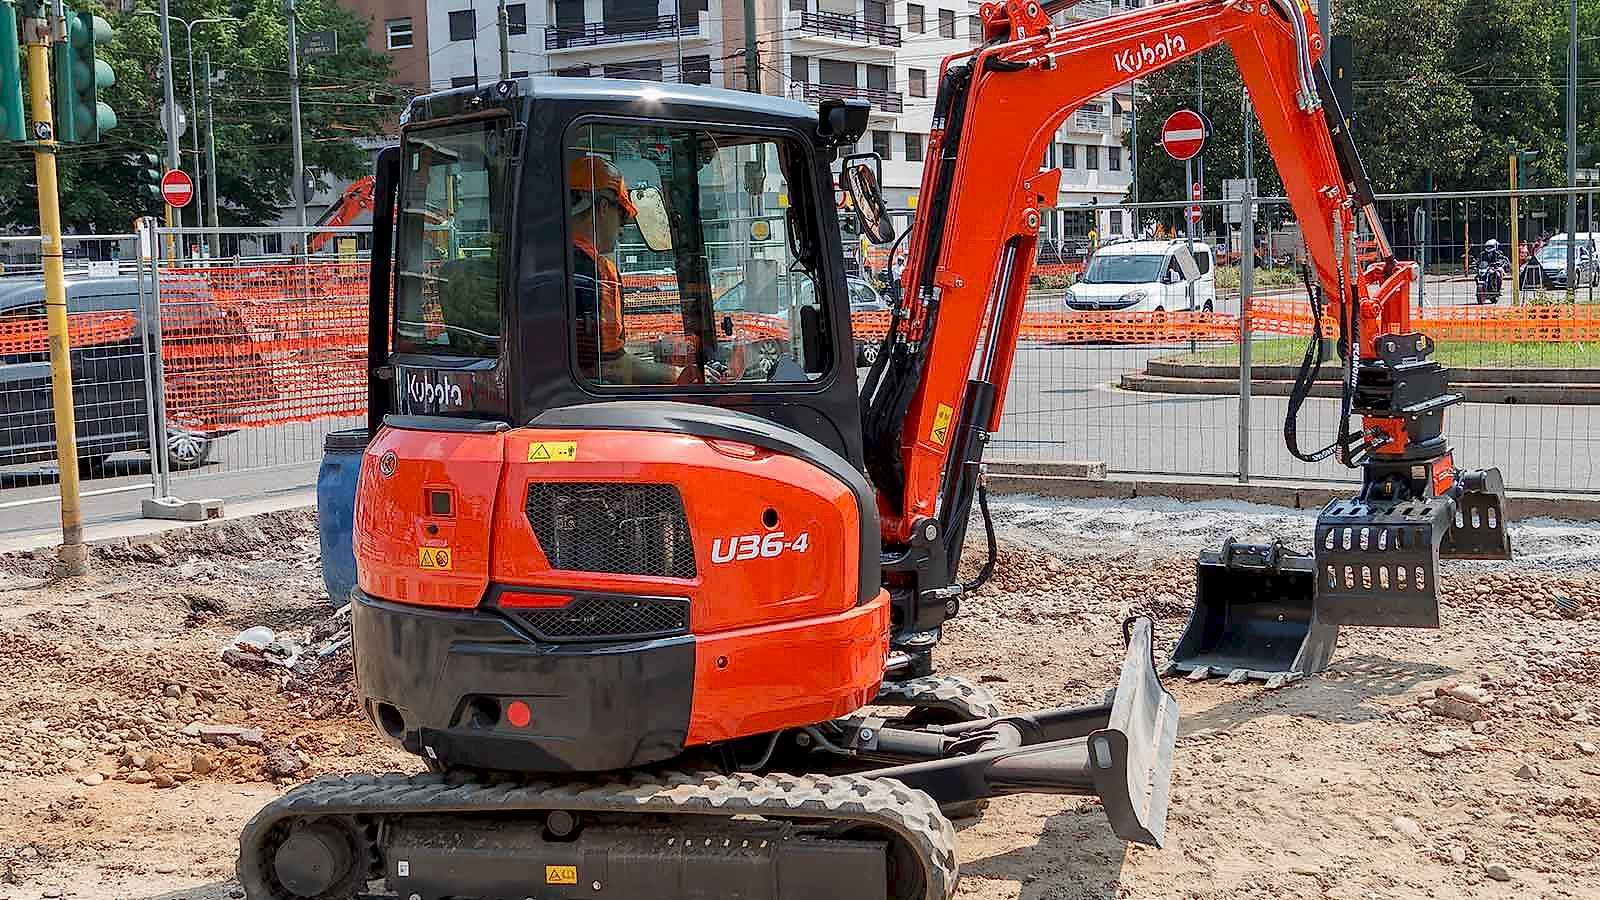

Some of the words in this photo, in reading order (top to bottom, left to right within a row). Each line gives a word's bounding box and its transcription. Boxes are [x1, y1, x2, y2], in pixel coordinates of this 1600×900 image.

[1114, 32, 1186, 73] Kubota
[407, 373, 463, 405] Kubota
[711, 531, 809, 563] U36-4
